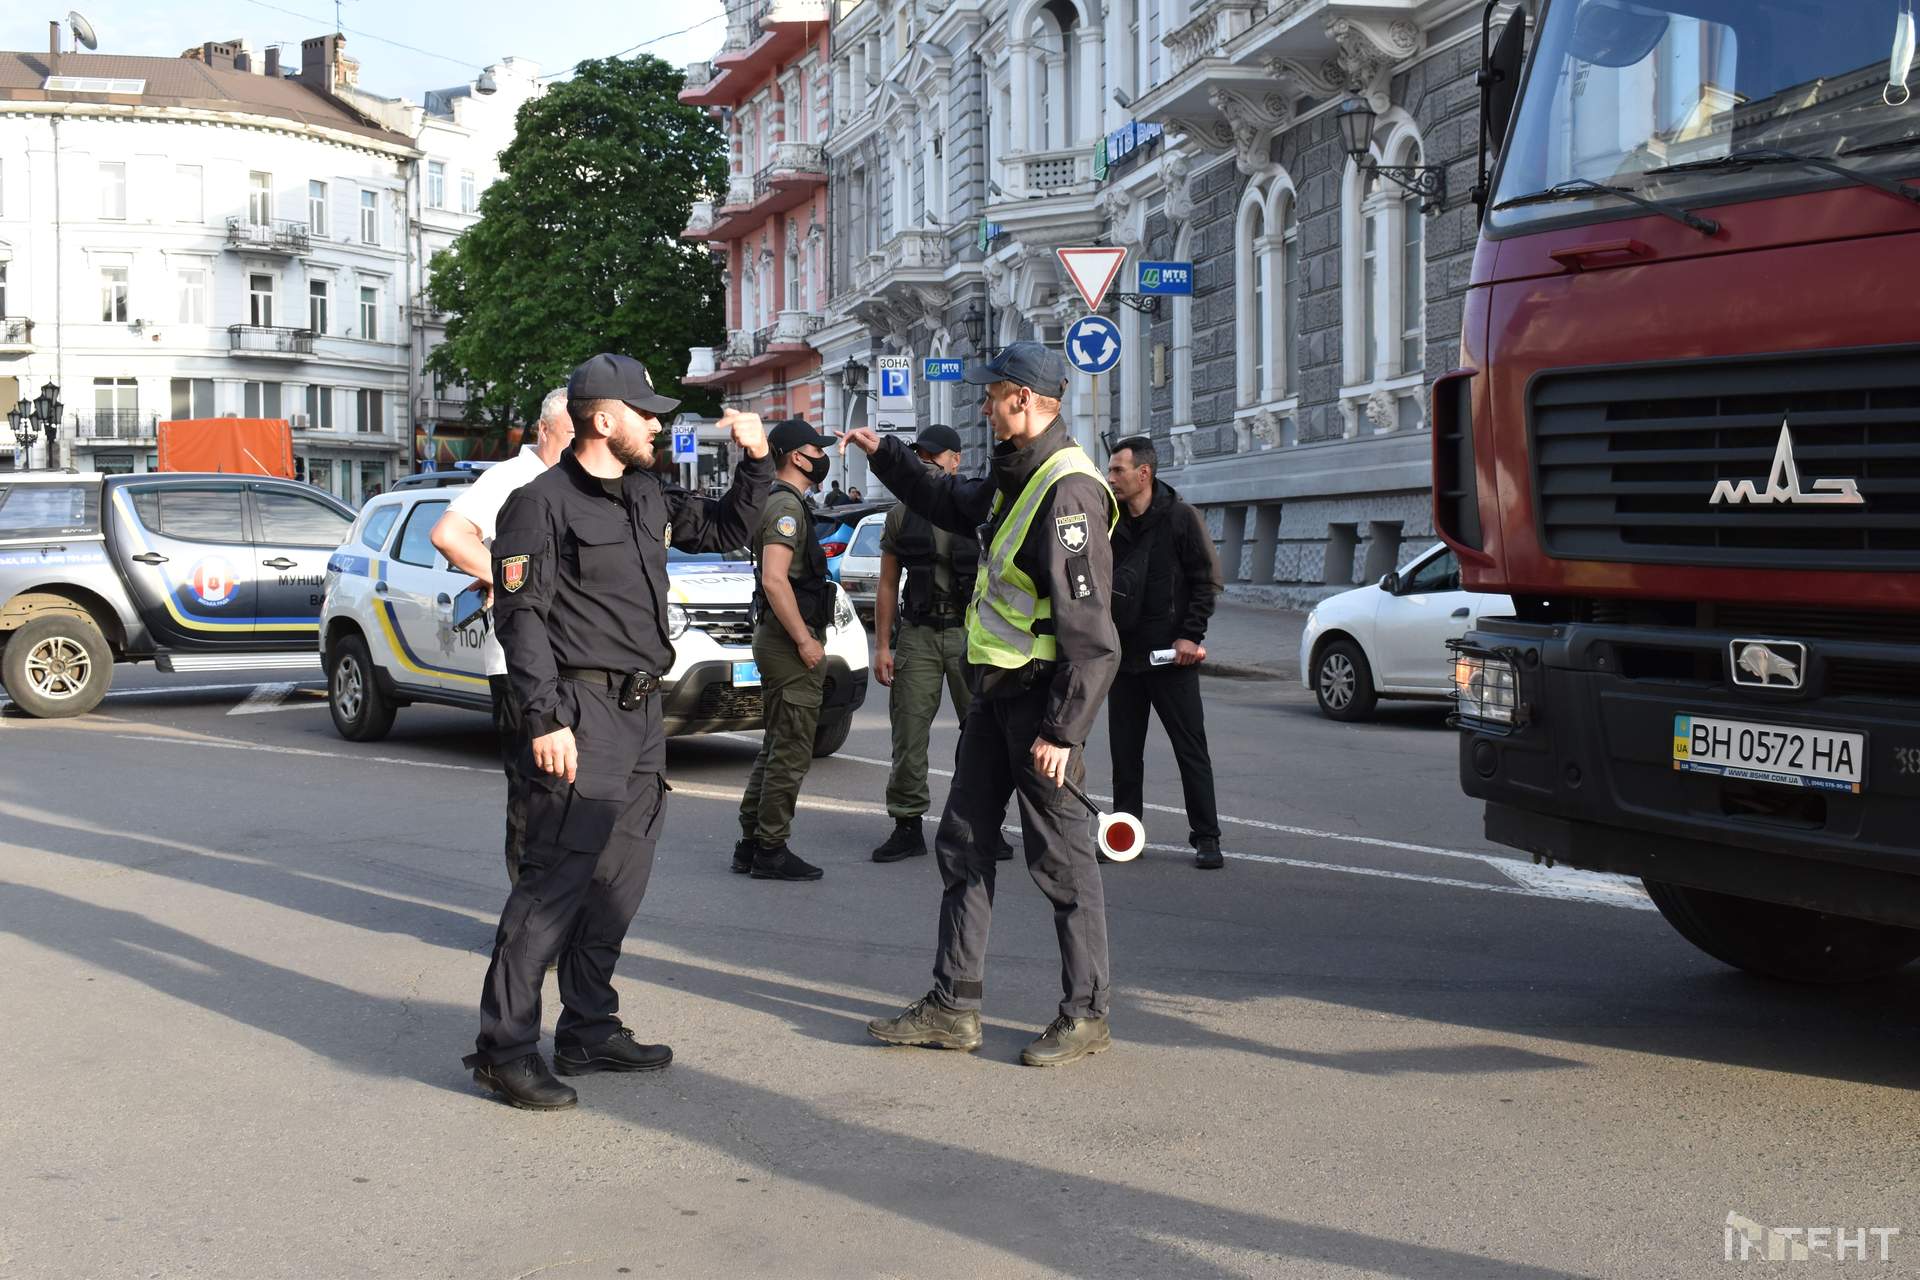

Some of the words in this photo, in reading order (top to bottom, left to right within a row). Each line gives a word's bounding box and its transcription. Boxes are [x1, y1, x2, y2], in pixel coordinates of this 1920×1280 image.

[1162, 269, 1188, 279] MTB
[880, 358, 910, 369] ЗОНА
[888, 371, 904, 395] P
[674, 426, 695, 434] ЗОНА
[1676, 743, 1688, 754] UA
[1691, 723, 1732, 760] BH
[1738, 728, 1805, 769] 0572
[1812, 736, 1854, 775] HA
